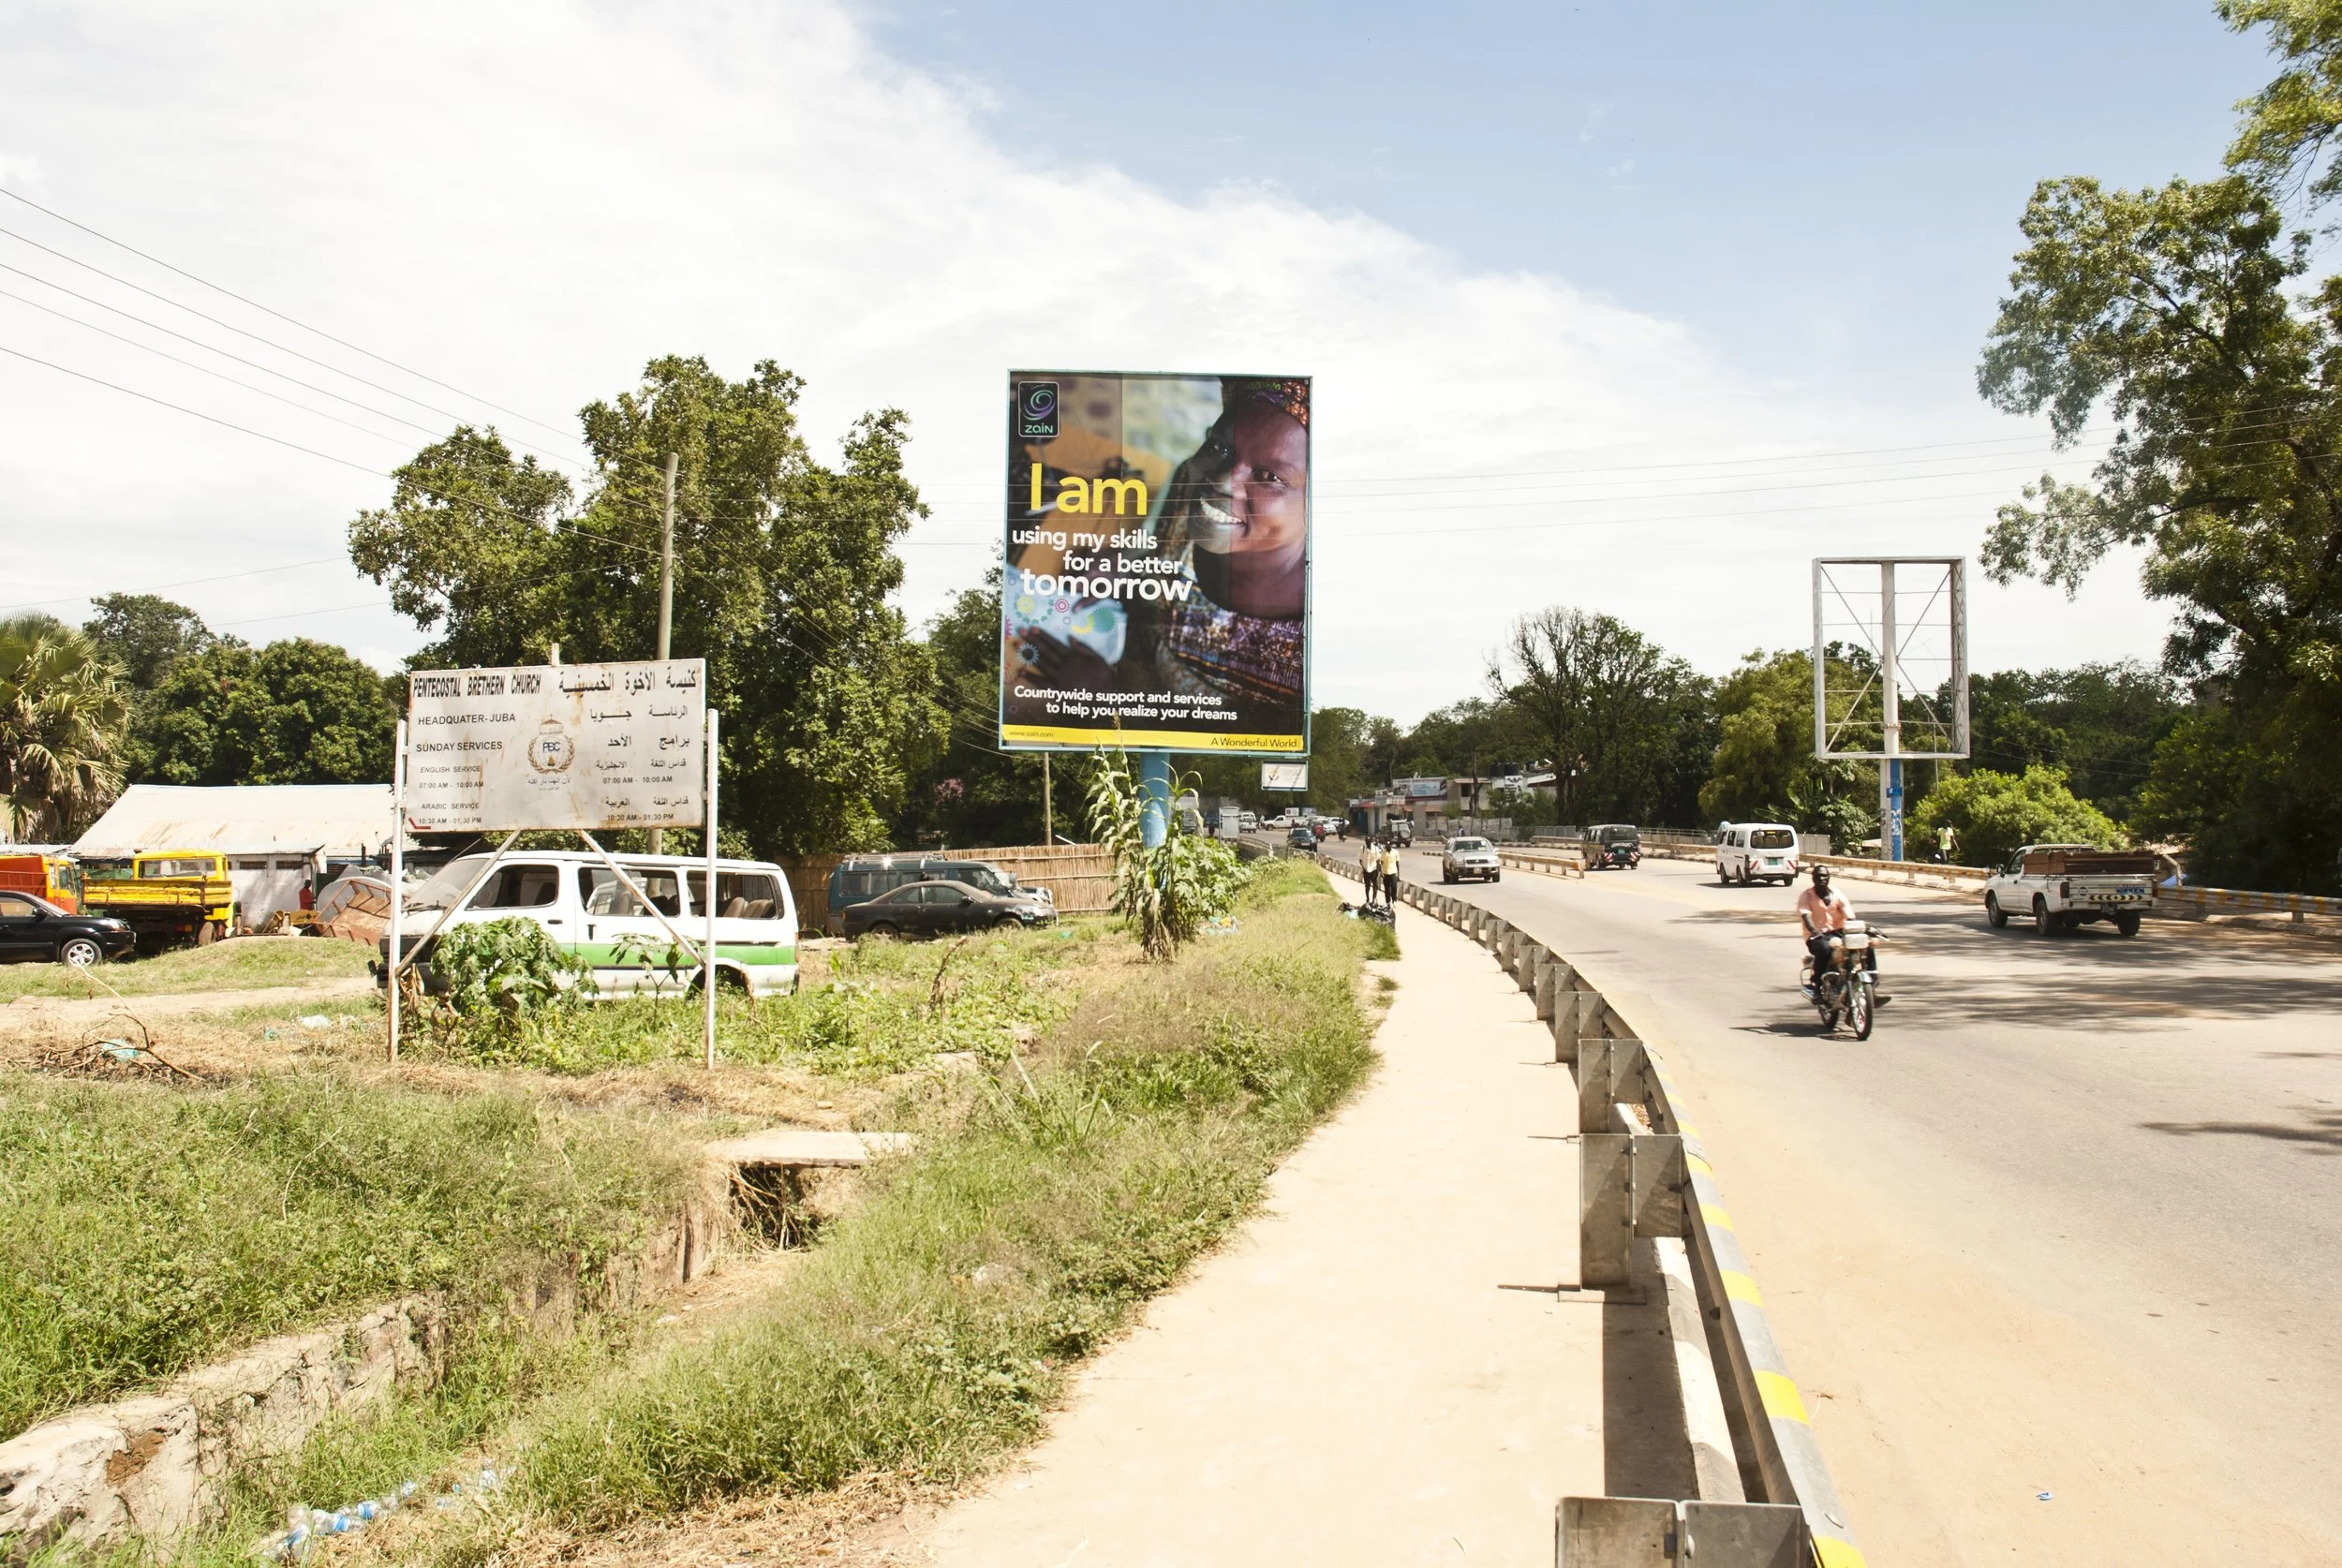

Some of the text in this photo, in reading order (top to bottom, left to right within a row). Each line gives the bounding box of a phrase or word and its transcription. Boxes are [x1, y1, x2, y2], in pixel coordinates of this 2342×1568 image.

[1030, 463, 1148, 515] I am
[1012, 525, 1158, 553] using my skills
[1062, 550, 1183, 574] for a better
[1019, 568, 1193, 601] tomorrow
[412, 673, 541, 698] PENTECOSTAL BRETHERN CHURCH
[558, 671, 615, 699] الخمسينية
[666, 666, 696, 694] كنيسة
[1014, 685, 1223, 706] Countrywide support and services
[489, 713, 516, 722] JUBA
[1045, 701, 1238, 720] to help you realize your dreams
[416, 741, 503, 752] SUNDAY SERVICES
[659, 734, 690, 750] برامج
[1210, 737, 1297, 747] A Wonderful World
